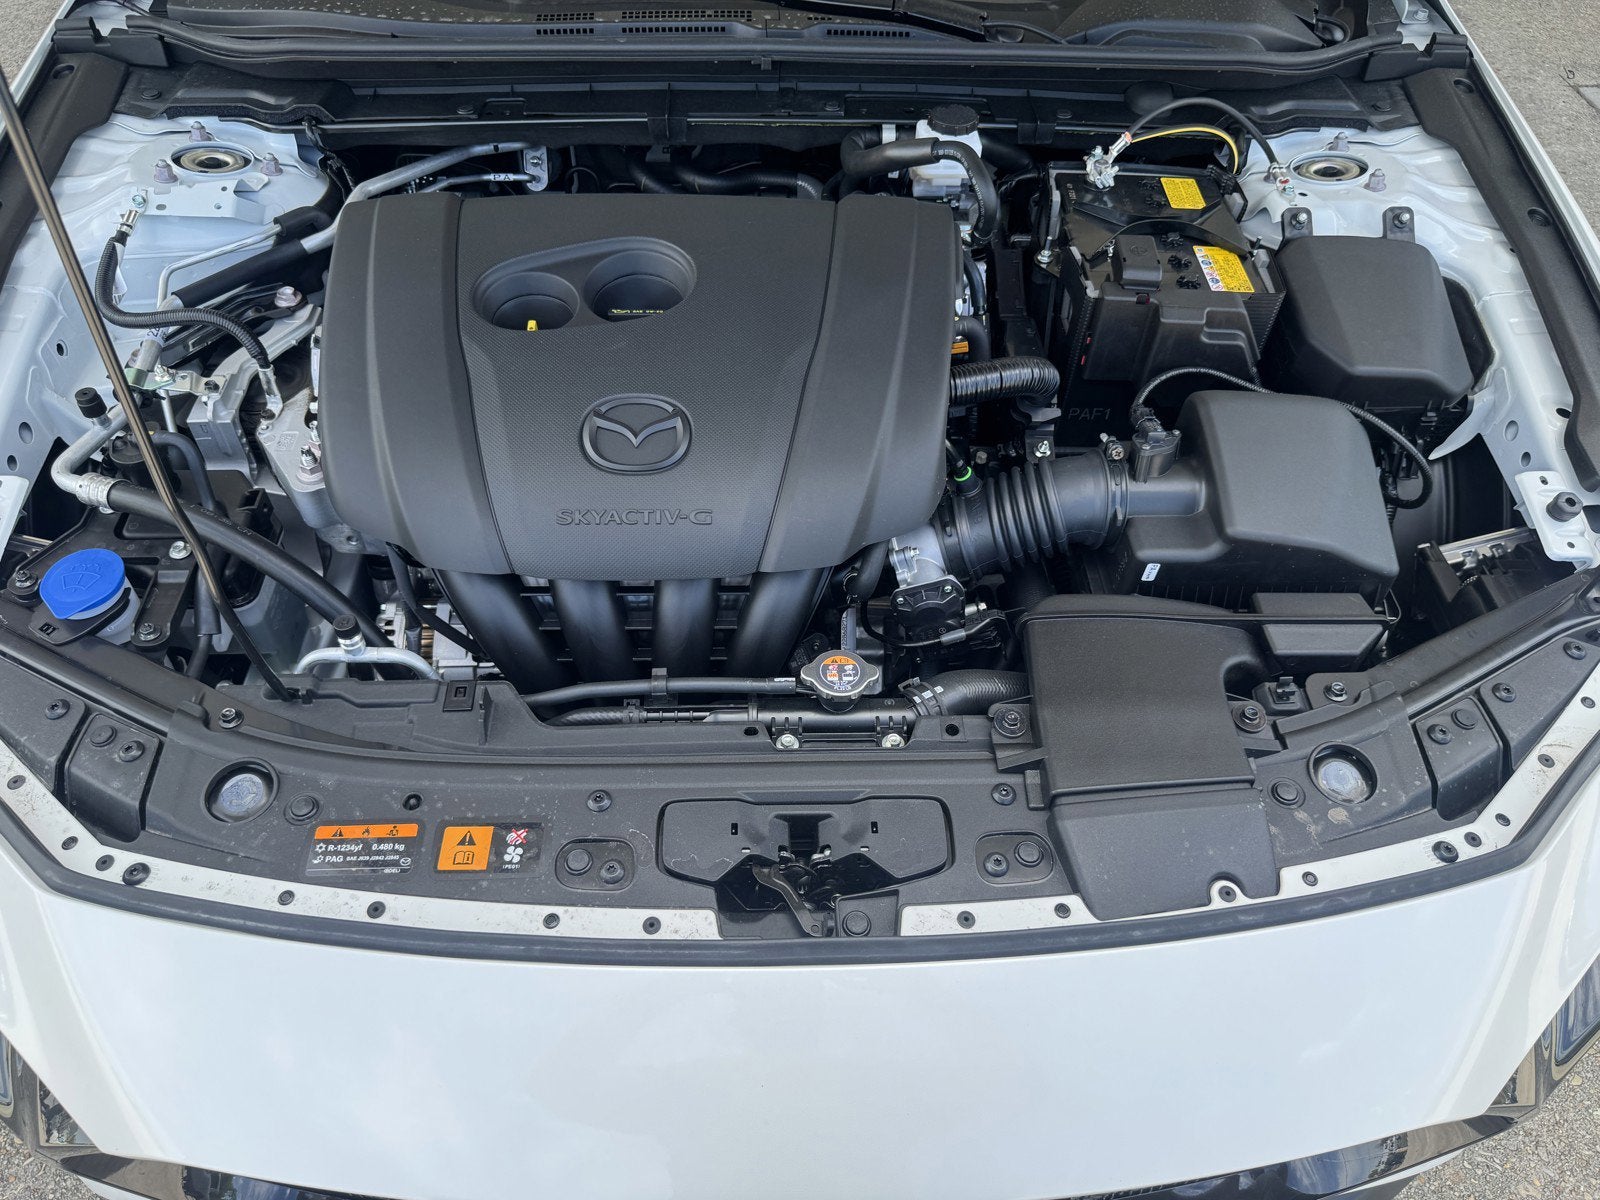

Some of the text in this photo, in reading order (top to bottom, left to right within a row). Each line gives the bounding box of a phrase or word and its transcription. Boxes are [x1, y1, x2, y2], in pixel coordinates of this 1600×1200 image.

[1068, 407, 1111, 420] PAF1
[555, 508, 713, 526] SKYACTIV-G
[327, 842, 406, 852] R-1234yf 0.480 kg
[325, 855, 343, 863] PAG
